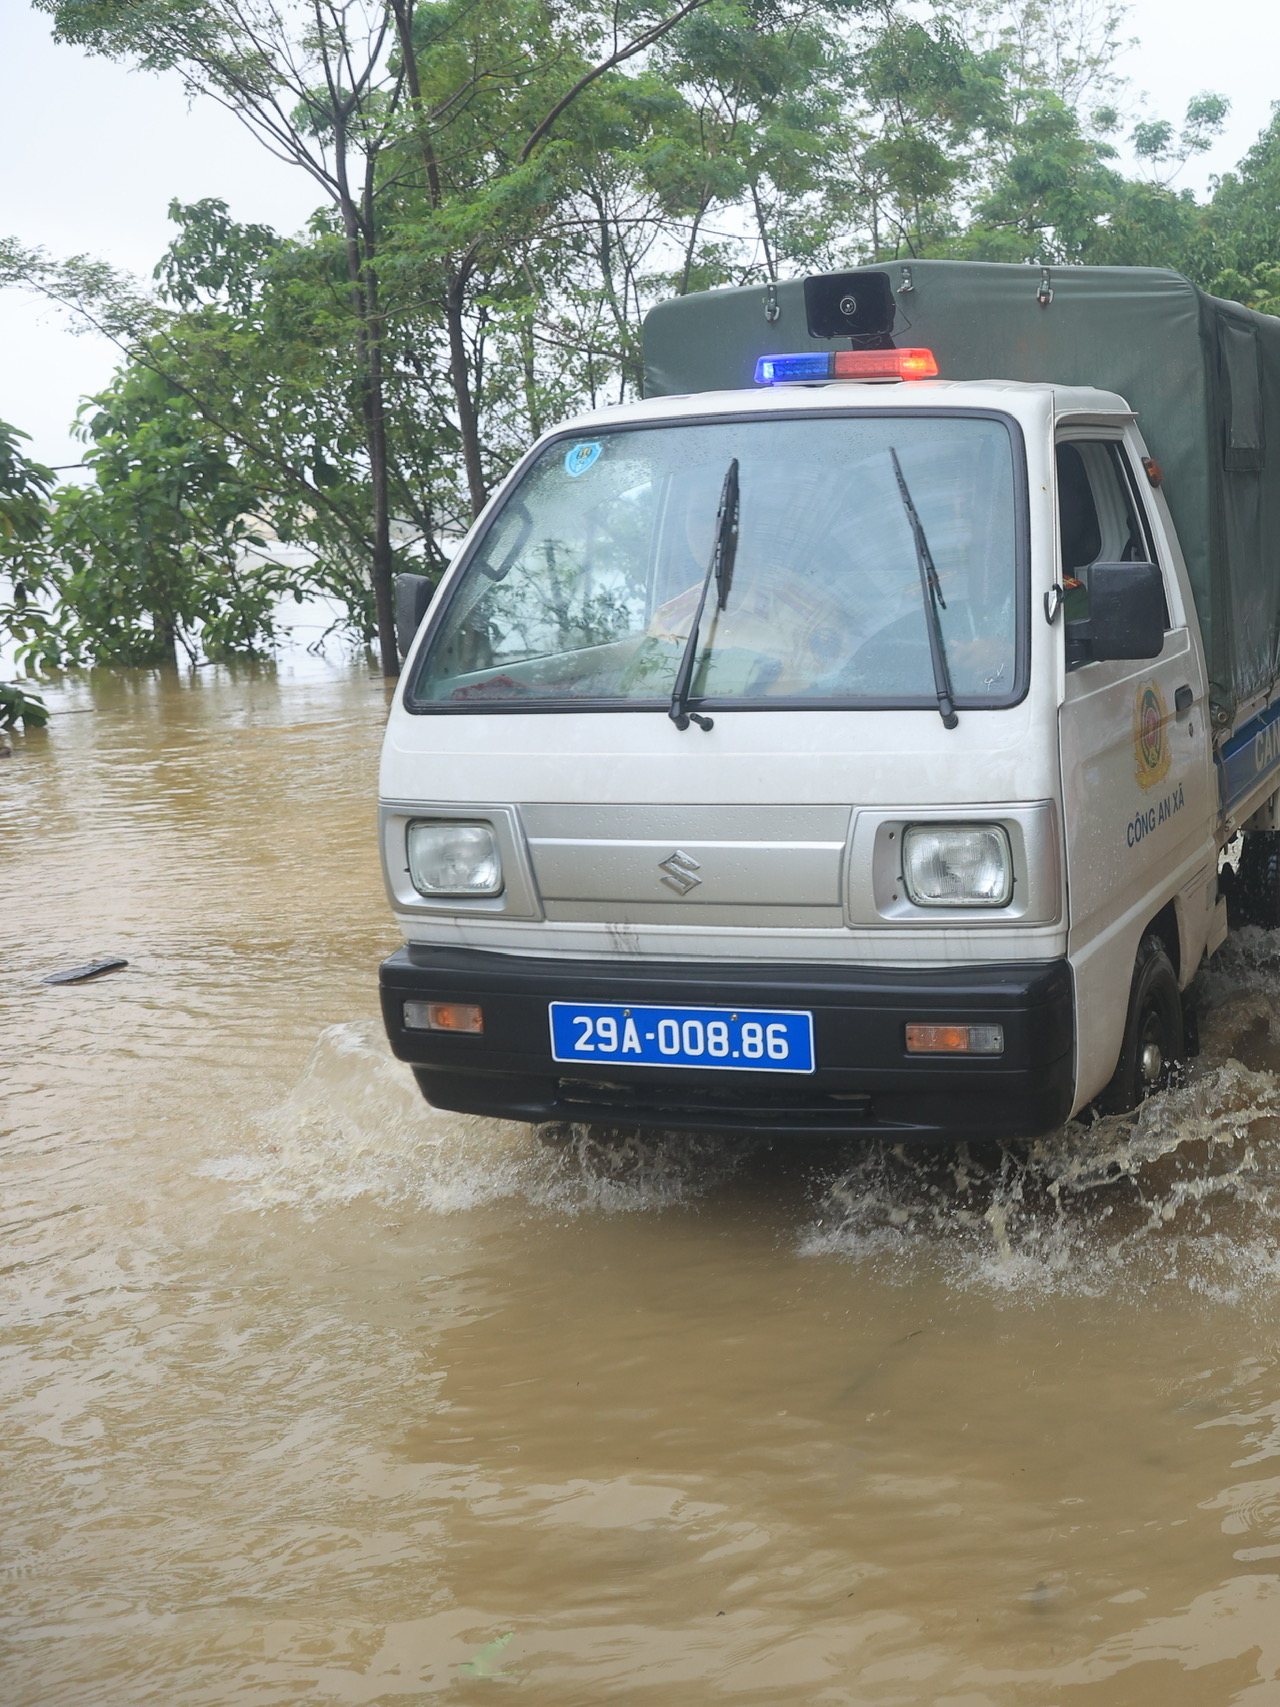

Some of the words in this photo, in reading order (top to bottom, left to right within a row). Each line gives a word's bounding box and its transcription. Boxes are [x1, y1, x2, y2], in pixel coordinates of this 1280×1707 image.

[1127, 808, 1156, 848] CÔNG
[1158, 796, 1171, 826] AN
[1173, 783, 1185, 810] XÃ
[573, 1016, 790, 1060] 29A-008.86
